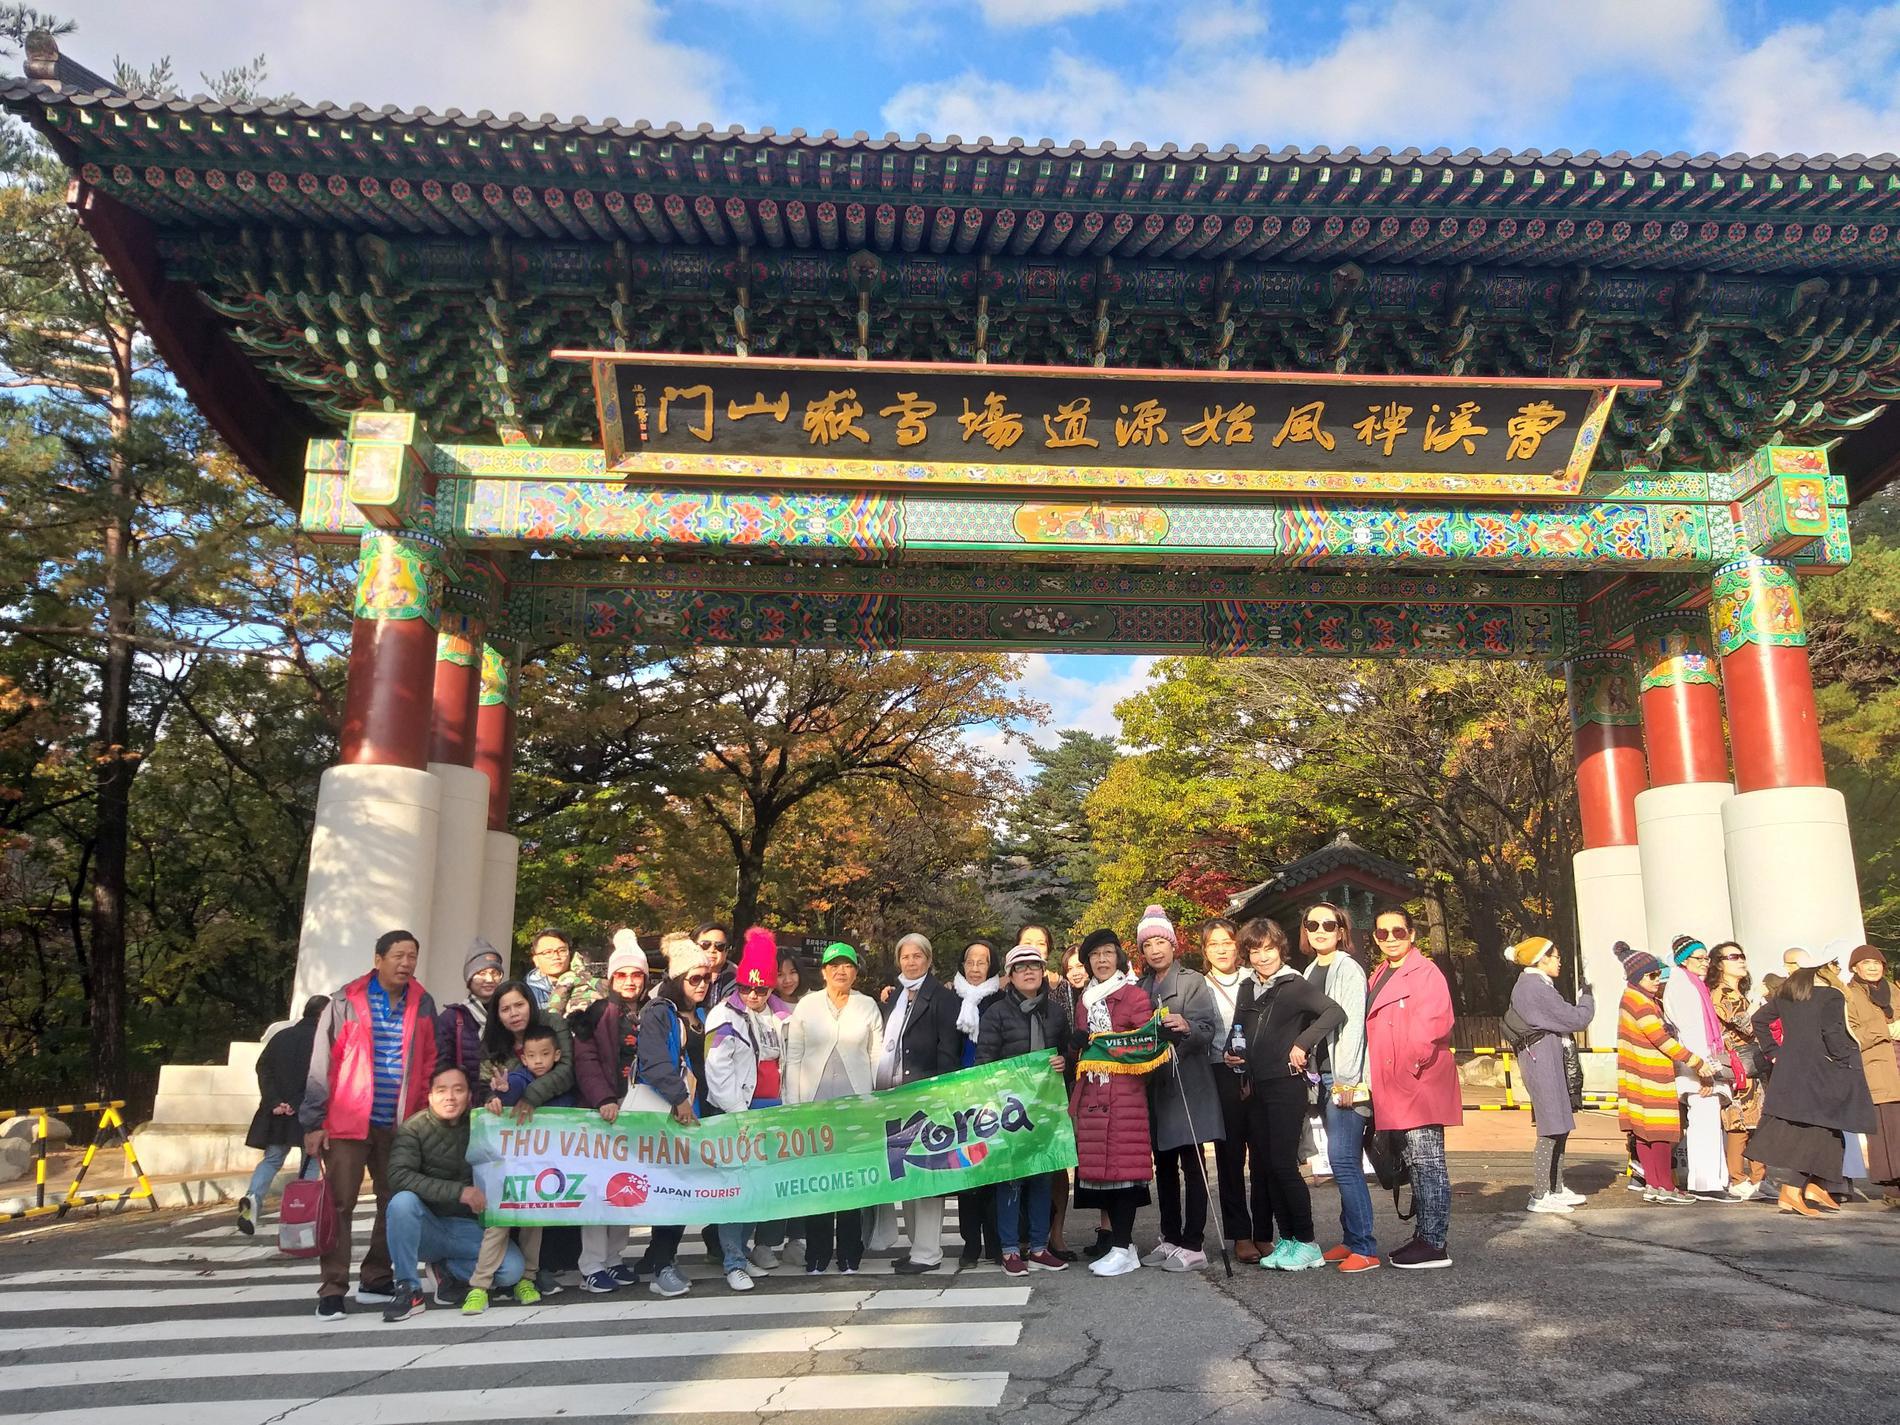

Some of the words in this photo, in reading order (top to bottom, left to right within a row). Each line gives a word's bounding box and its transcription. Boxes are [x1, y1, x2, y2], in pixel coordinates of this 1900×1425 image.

[499, 1128, 551, 1157] THU
[560, 1126, 629, 1162] VÀNG
[637, 1130, 691, 1165] HÀN
[700, 1125, 768, 1168] QUỐC
[776, 1124, 834, 1159] 2019
[885, 1096, 1035, 1181] Korea
[501, 1167, 588, 1202] ATOZ
[653, 1185, 692, 1198] JAPAN
[694, 1187, 741, 1198] TOURIST
[774, 1170, 855, 1198] WELCOME
[857, 1166, 880, 1186] TO
